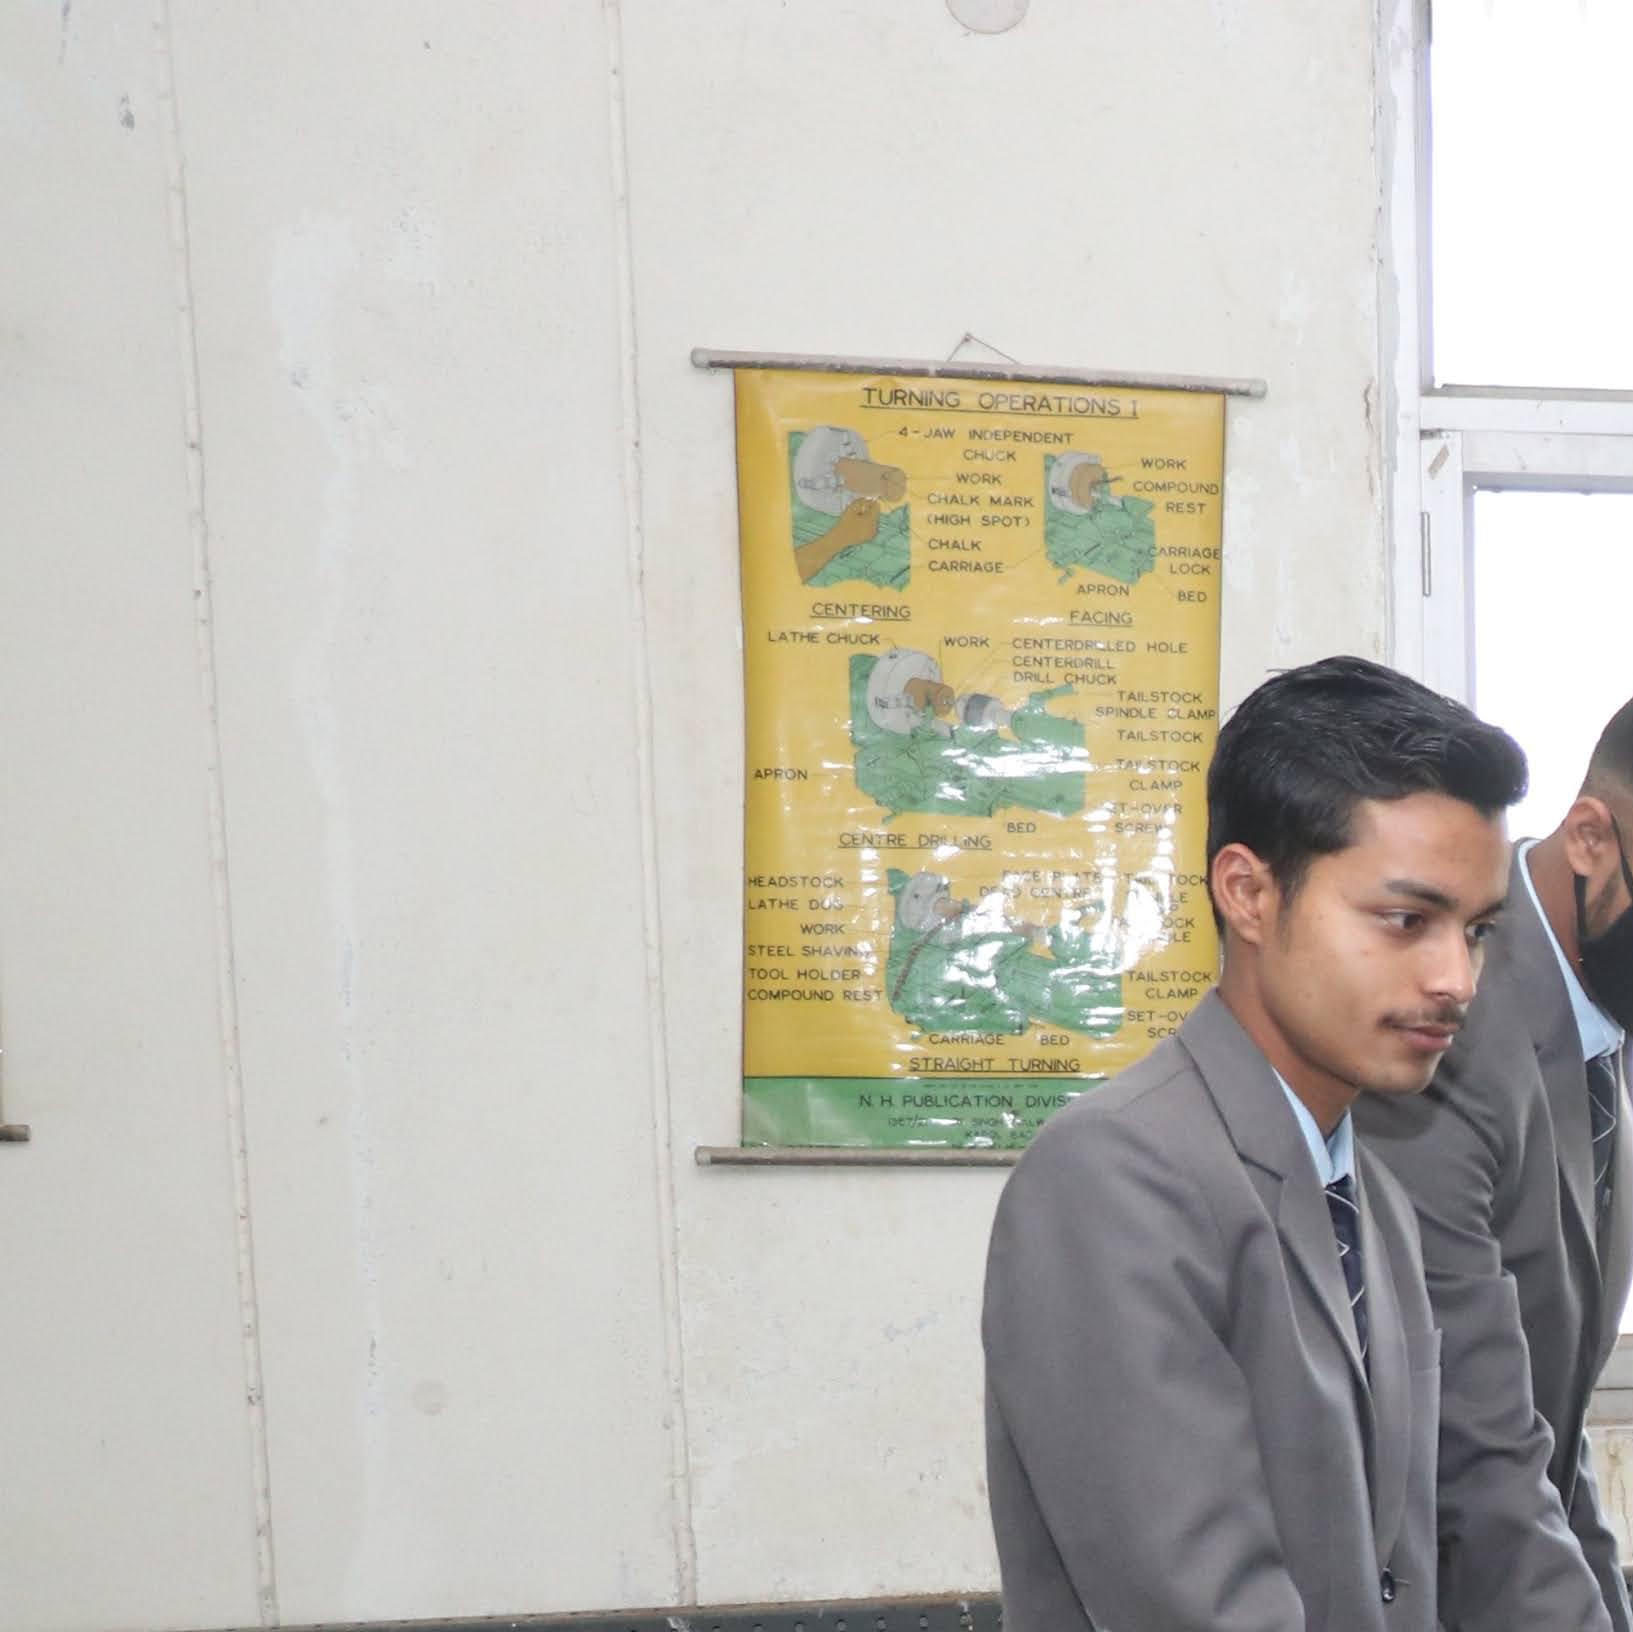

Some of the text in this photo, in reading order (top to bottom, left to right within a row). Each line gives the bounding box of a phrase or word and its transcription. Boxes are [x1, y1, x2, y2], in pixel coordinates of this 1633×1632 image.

[862, 387, 1138, 416] TURNING OPERATIONS I
[969, 429, 1074, 444] INDEPENDENT
[963, 448, 1016, 461] CHUCK
[1141, 457, 1187, 470] WORK
[957, 472, 1003, 485] WORK
[1133, 480, 1220, 496] COMPOUND
[927, 493, 1034, 507] CHALK MARK
[1166, 501, 1207, 514] REST
[927, 514, 1031, 528] (HIGH SPOT)
[927, 538, 981, 551] CHALK
[1147, 545, 1221, 560] CARRIAGE
[927, 560, 1004, 574] CARRIAGE
[1169, 563, 1211, 575] LOCK
[1077, 583, 1130, 596] APRON
[1177, 590, 1208, 603] BED
[811, 602, 911, 619] CENTERING
[1070, 610, 1133, 625] FACING
[767, 631, 880, 645] LATHE CHUCK
[944, 635, 990, 648] WORK
[1147, 641, 1189, 654] HOLE
[1012, 655, 1116, 670] CENTERDRILL
[1013, 672, 1117, 686] DRILL CHUCK
[1117, 690, 1203, 704] TAILSTOCK
[1095, 707, 1216, 720] SPINDLE CLAMP
[1117, 730, 1203, 744] TAILSTOCK
[1114, 758, 1201, 773] TAILSTOCK
[753, 768, 808, 781] APRON
[1129, 778, 1183, 792] CLAMP
[1006, 821, 1037, 834] BED
[839, 833, 907, 847] CENTRE
[747, 875, 845, 888] HEADSTOCK
[747, 898, 799, 910] LATHE
[800, 923, 846, 935] WORK
[747, 944, 795, 957] STEEL
[749, 968, 861, 981] TOOL HOLDER
[1127, 969, 1213, 983] TAILSTOCK
[747, 989, 883, 1001] COMPOUND REST
[1144, 987, 1199, 1000] CLAMP
[1127, 1010, 1187, 1022] SET-OV
[928, 1033, 1071, 1046] CARRIAGE BED
[909, 1057, 1081, 1072] STRAIGHT TURNING
